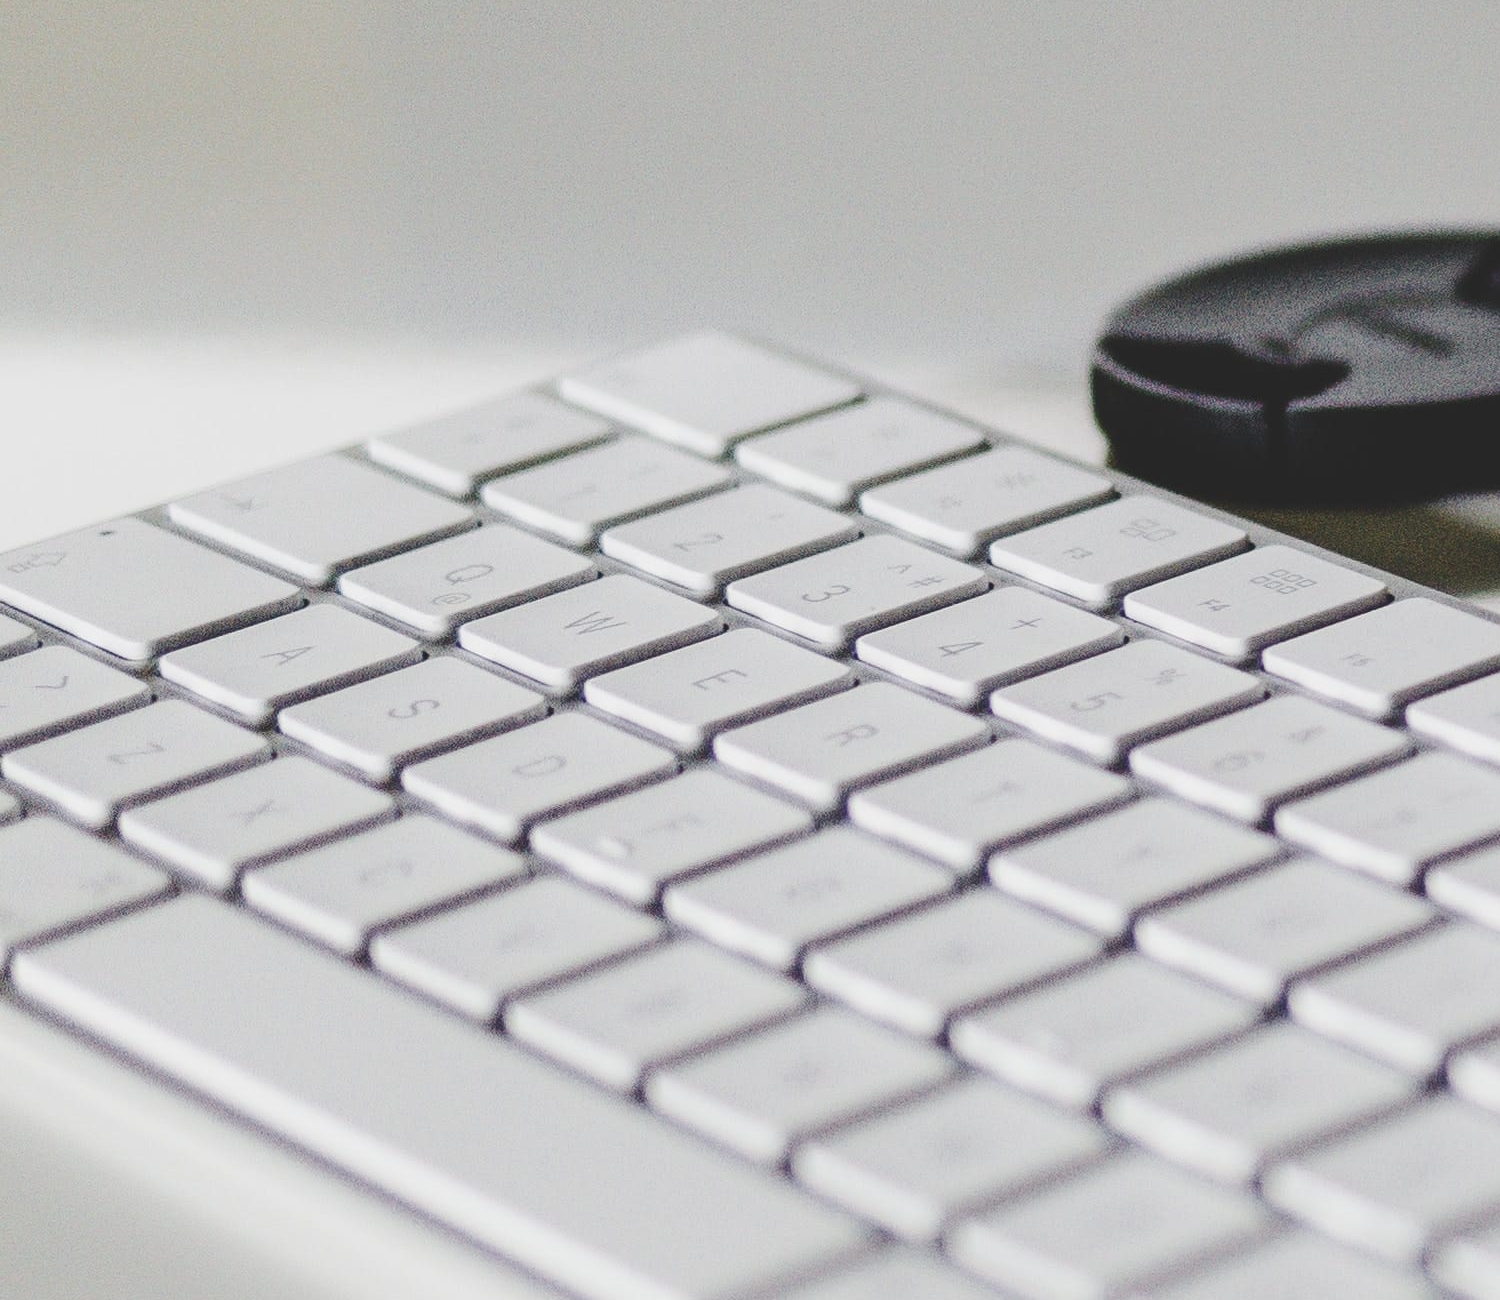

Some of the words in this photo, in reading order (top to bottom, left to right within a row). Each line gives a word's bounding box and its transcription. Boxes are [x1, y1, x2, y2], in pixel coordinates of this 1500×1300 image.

[671, 532, 724, 554] 2
[443, 563, 495, 587] Q
[907, 576, 944, 589] #
[428, 591, 472, 608] @
[801, 584, 852, 604] 3
[1199, 597, 1231, 614] F4
[564, 610, 627, 636] W
[1012, 617, 1040, 631] +
[262, 645, 314, 667] A
[938, 640, 983, 658] 4
[691, 668, 747, 691] E
[386, 699, 441, 720] S
[1069, 691, 1121, 714] 5
[826, 723, 879, 747] R
[106, 741, 165, 767] Z
[510, 754, 568, 778] D
